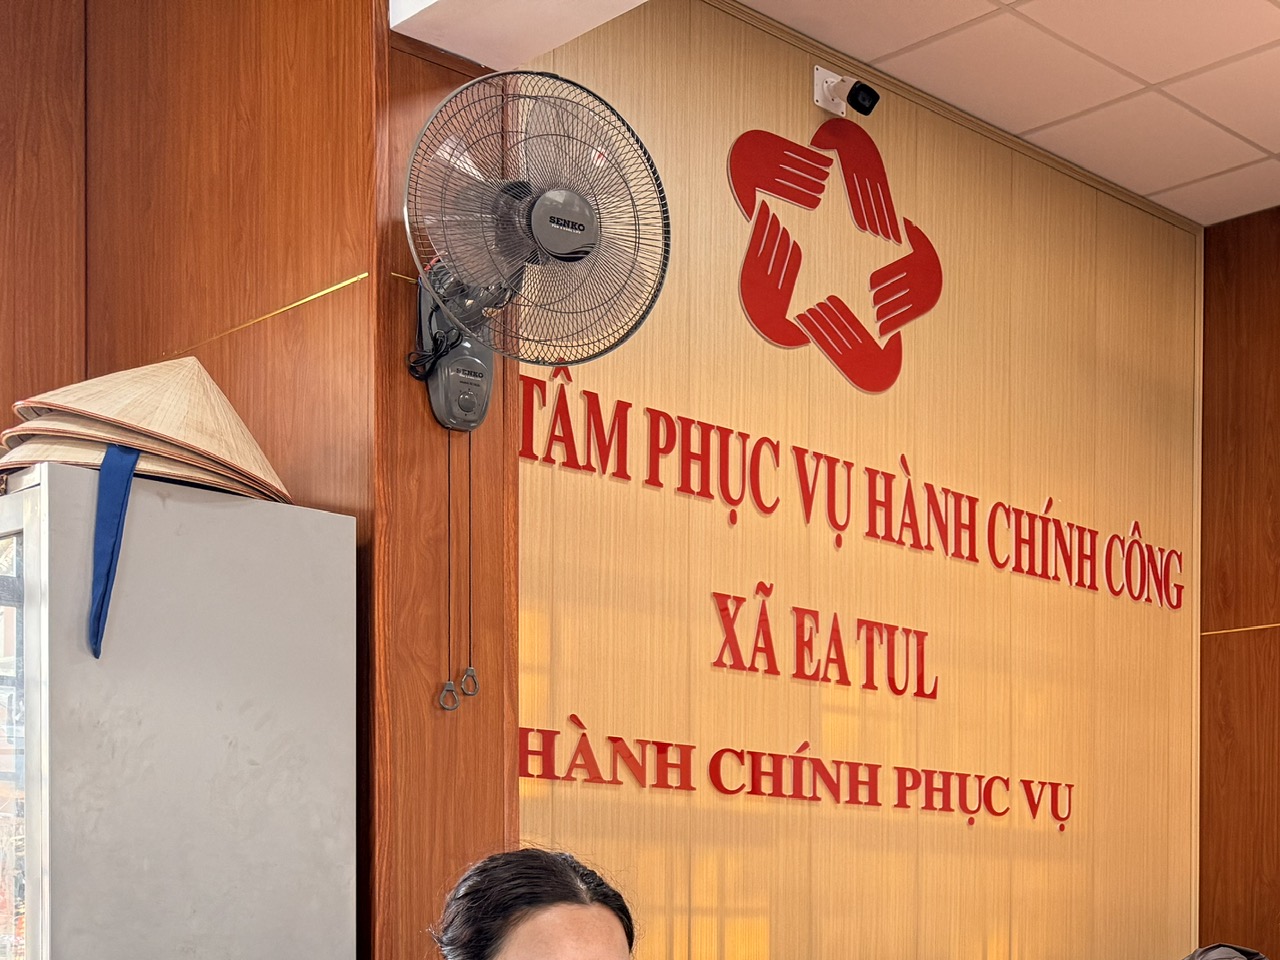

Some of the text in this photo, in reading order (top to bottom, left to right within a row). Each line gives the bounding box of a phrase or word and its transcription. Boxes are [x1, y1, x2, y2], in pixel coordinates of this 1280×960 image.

[549, 215, 586, 232] SENKO
[456, 368, 484, 379] SENKO
[518, 359, 1185, 611] TÂM PHỤC VỤ HÀNH CHÍNH CÔNG
[713, 581, 938, 701] XÃ EA TUL
[518, 714, 1075, 833] HÀNH CHÍNH PHỤC VỤ
